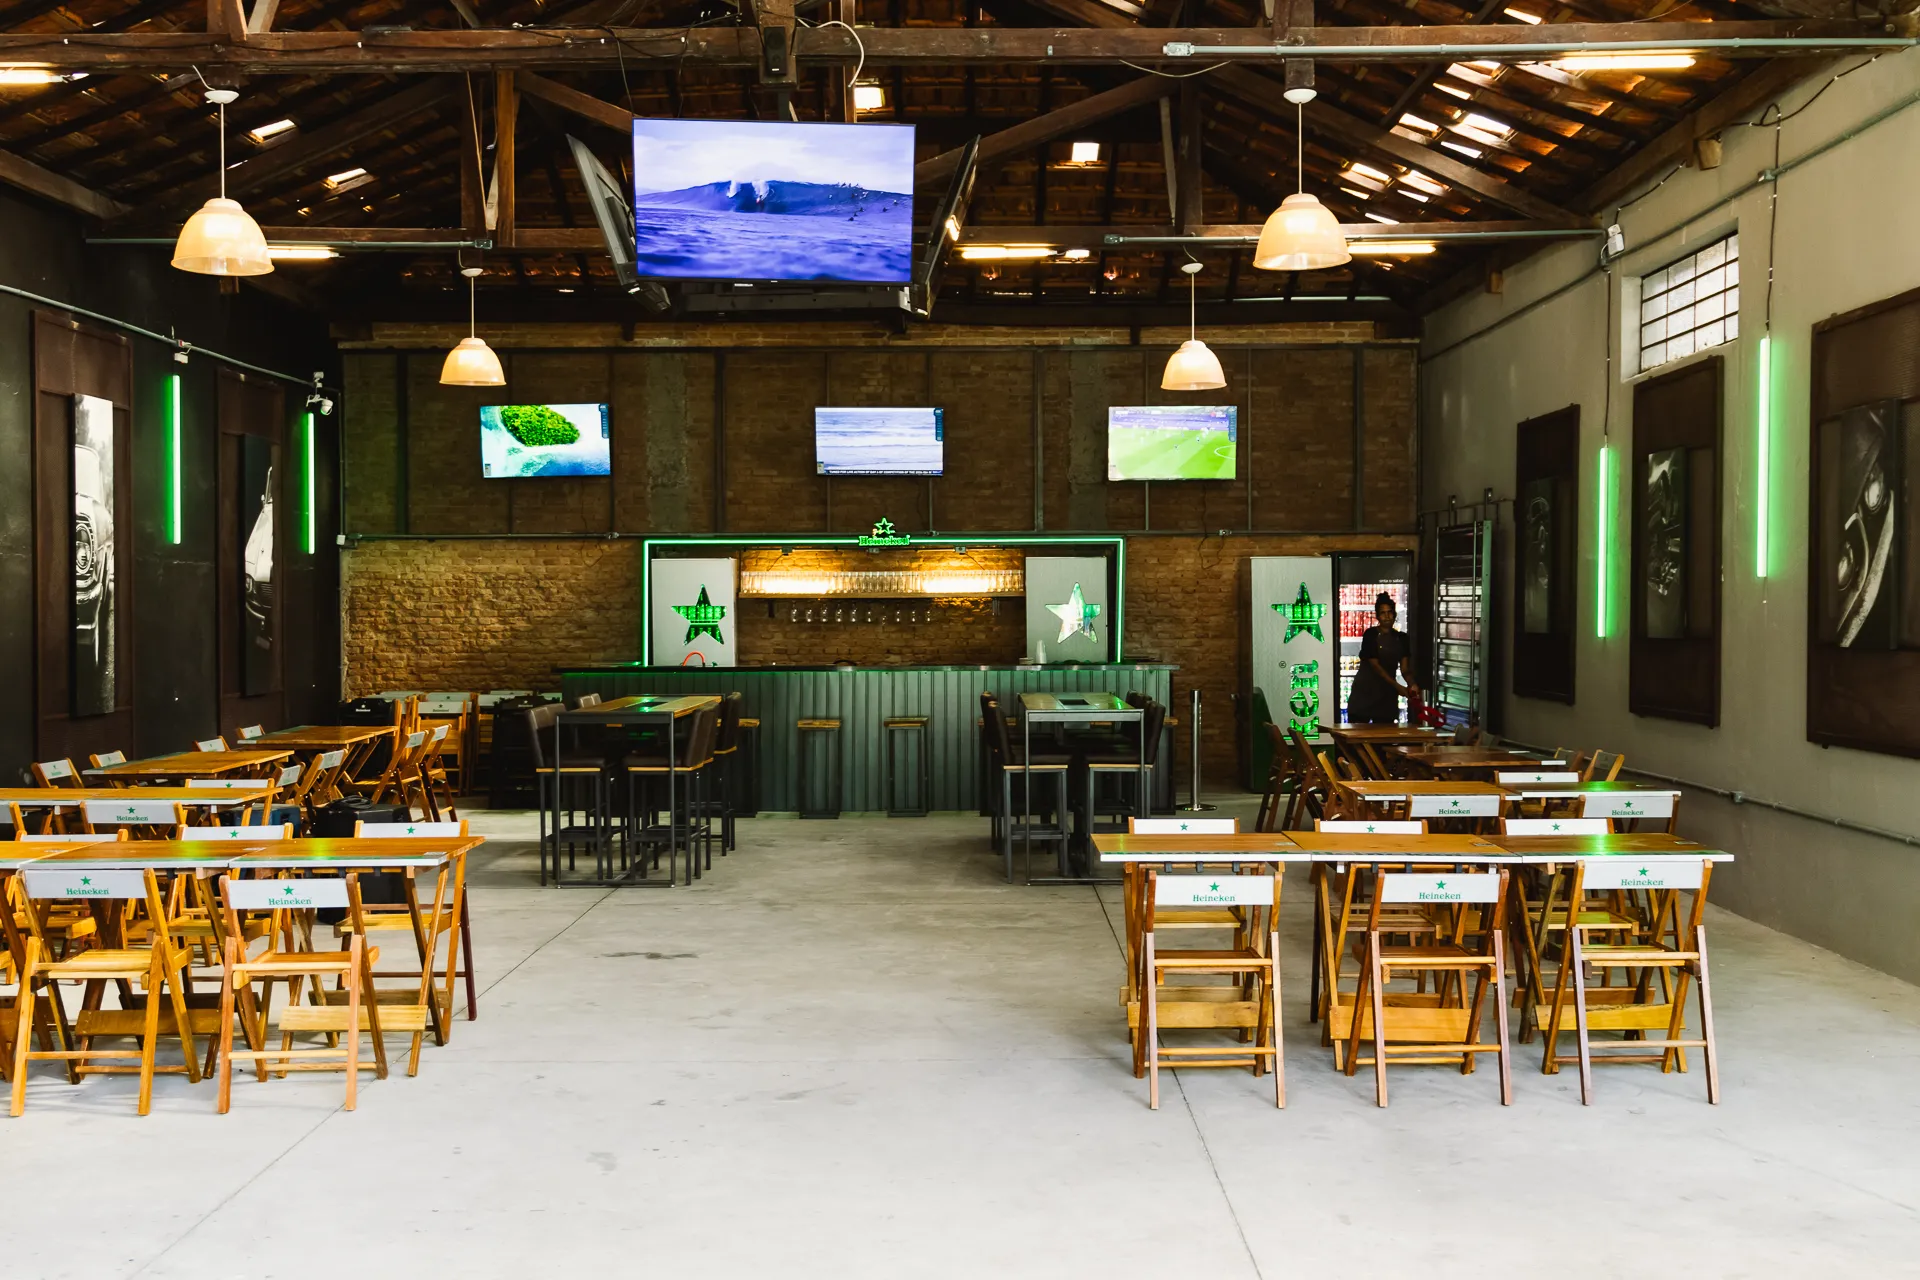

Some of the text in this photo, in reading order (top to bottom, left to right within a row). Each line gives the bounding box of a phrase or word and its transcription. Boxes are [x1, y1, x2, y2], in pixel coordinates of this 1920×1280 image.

[858, 535, 911, 546] Heineken
[1620, 878, 1664, 886] Heineken
[65, 887, 110, 896] Heineken
[1418, 891, 1462, 900] Heineken
[267, 897, 313, 906] Heineken
[1192, 894, 1236, 902] Heineken
